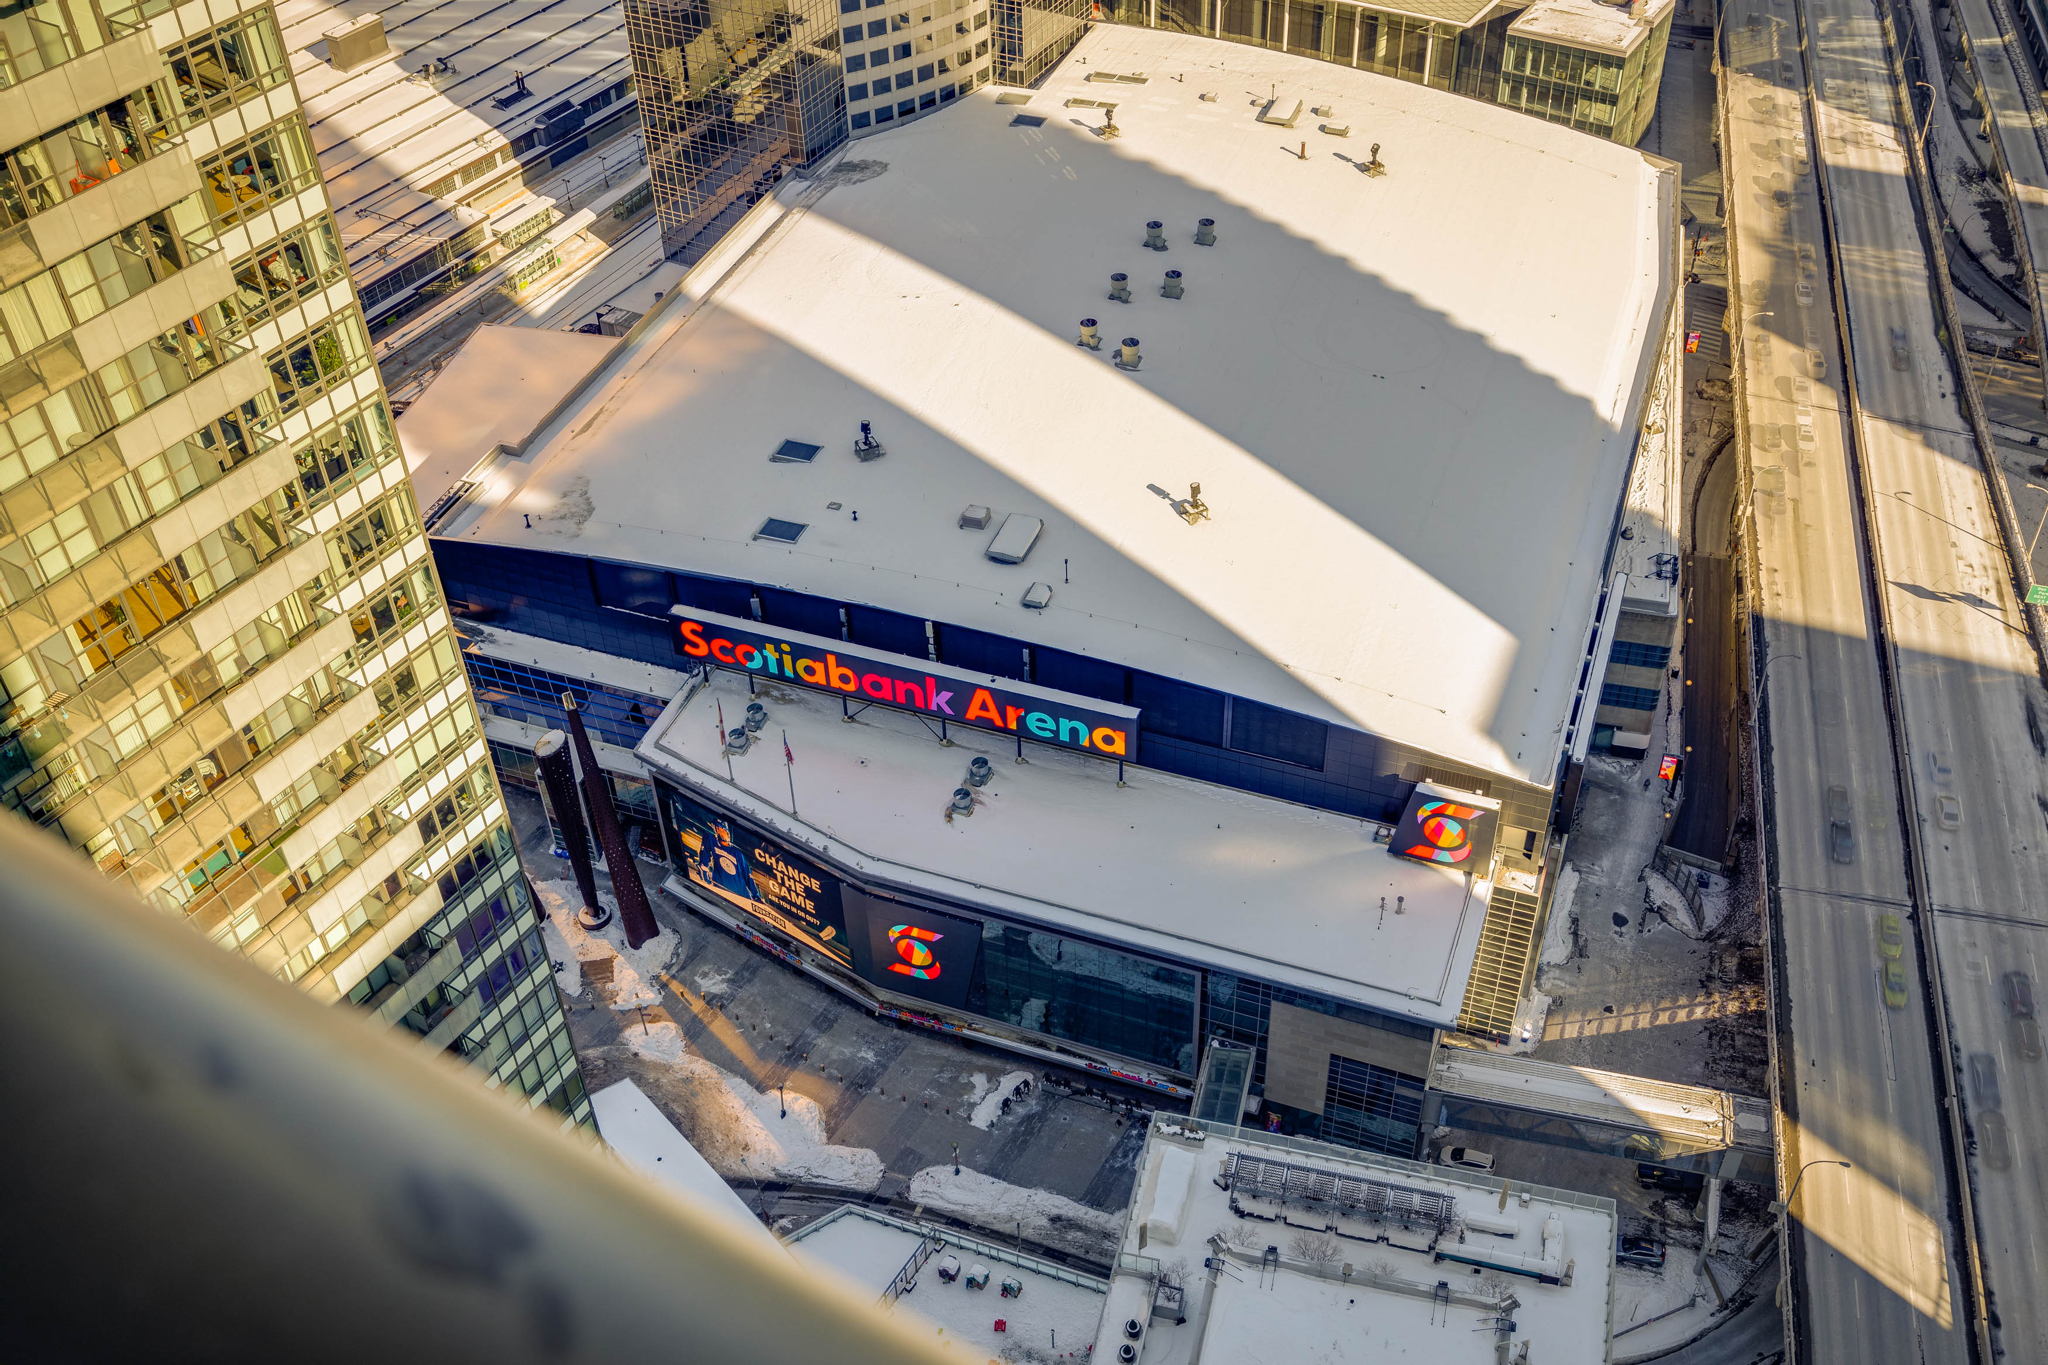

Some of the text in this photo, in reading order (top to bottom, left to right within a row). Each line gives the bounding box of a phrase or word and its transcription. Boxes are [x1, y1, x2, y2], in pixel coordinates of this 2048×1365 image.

[680, 621, 1127, 756] Scotiabank Arena
[754, 848, 822, 893] CHANGE
[773, 869, 806, 897] THE
[768, 880, 816, 914] GAME
[780, 899, 791, 910] YOU
